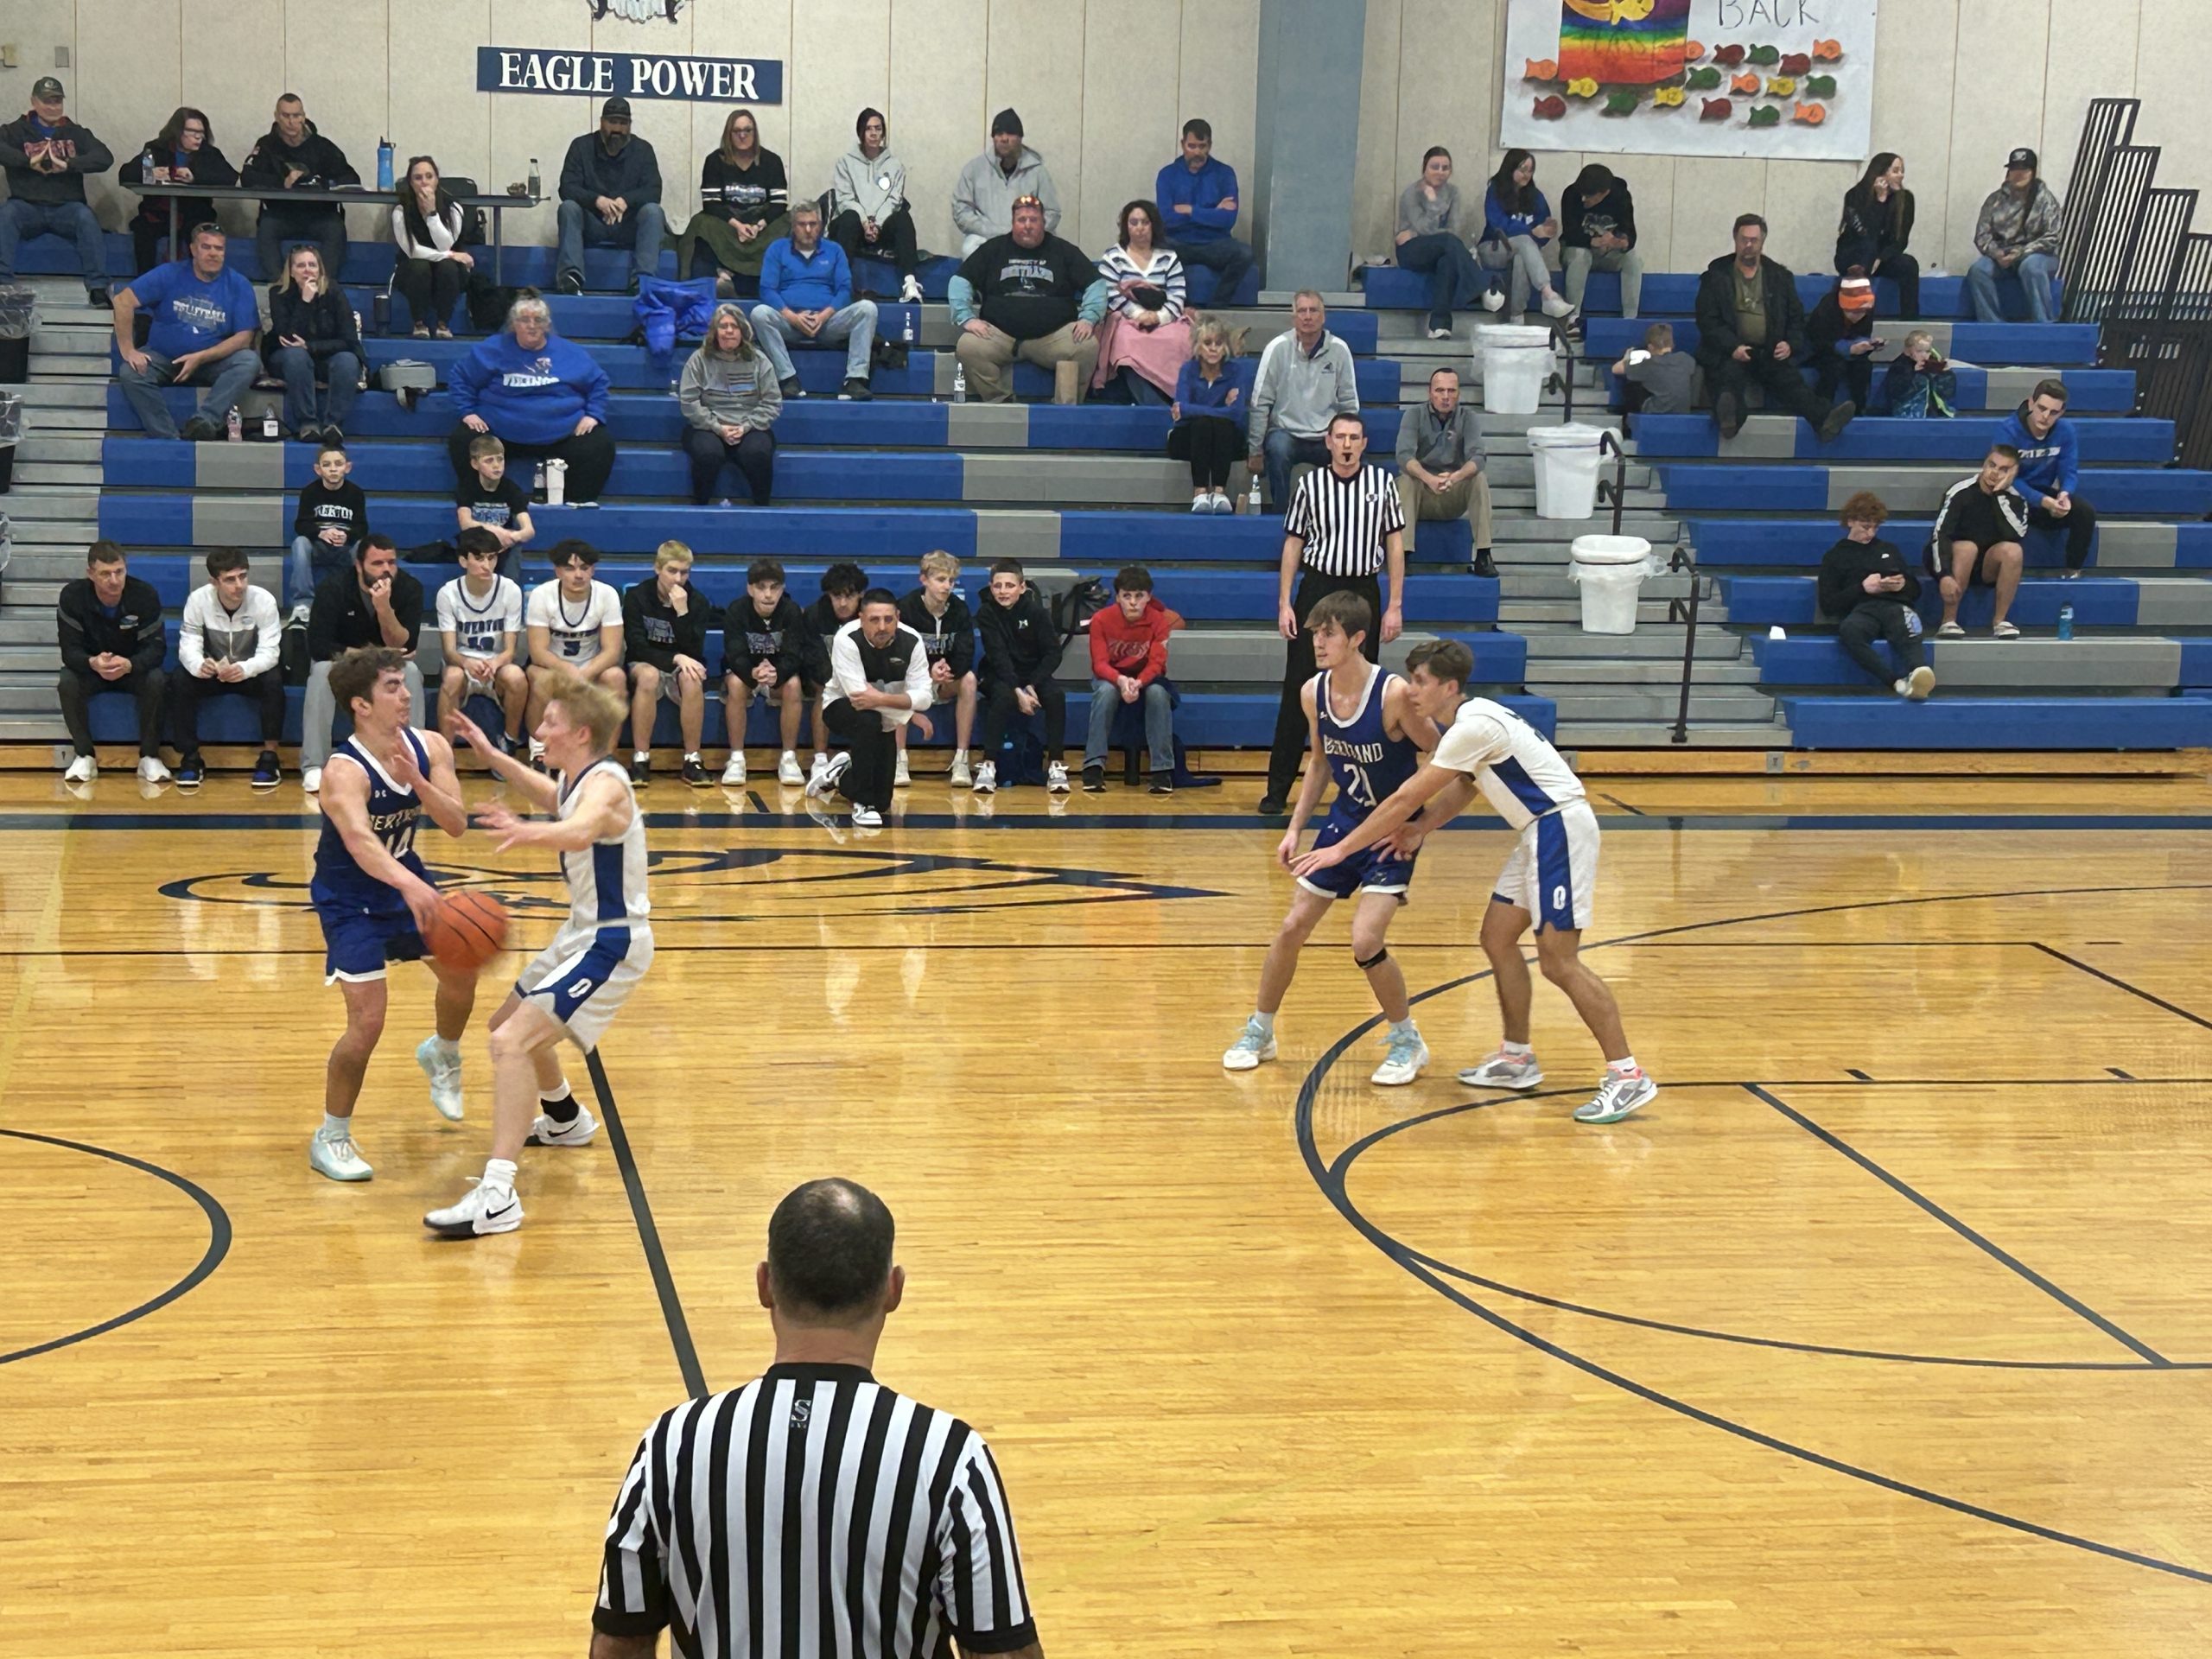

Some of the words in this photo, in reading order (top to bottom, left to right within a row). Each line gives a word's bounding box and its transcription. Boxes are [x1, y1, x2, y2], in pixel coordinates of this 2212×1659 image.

[1718, 0, 1820, 29] BACK
[499, 52, 614, 92] EAGLE
[630, 58, 760, 100] POWER
[1343, 764, 1377, 807] 21
